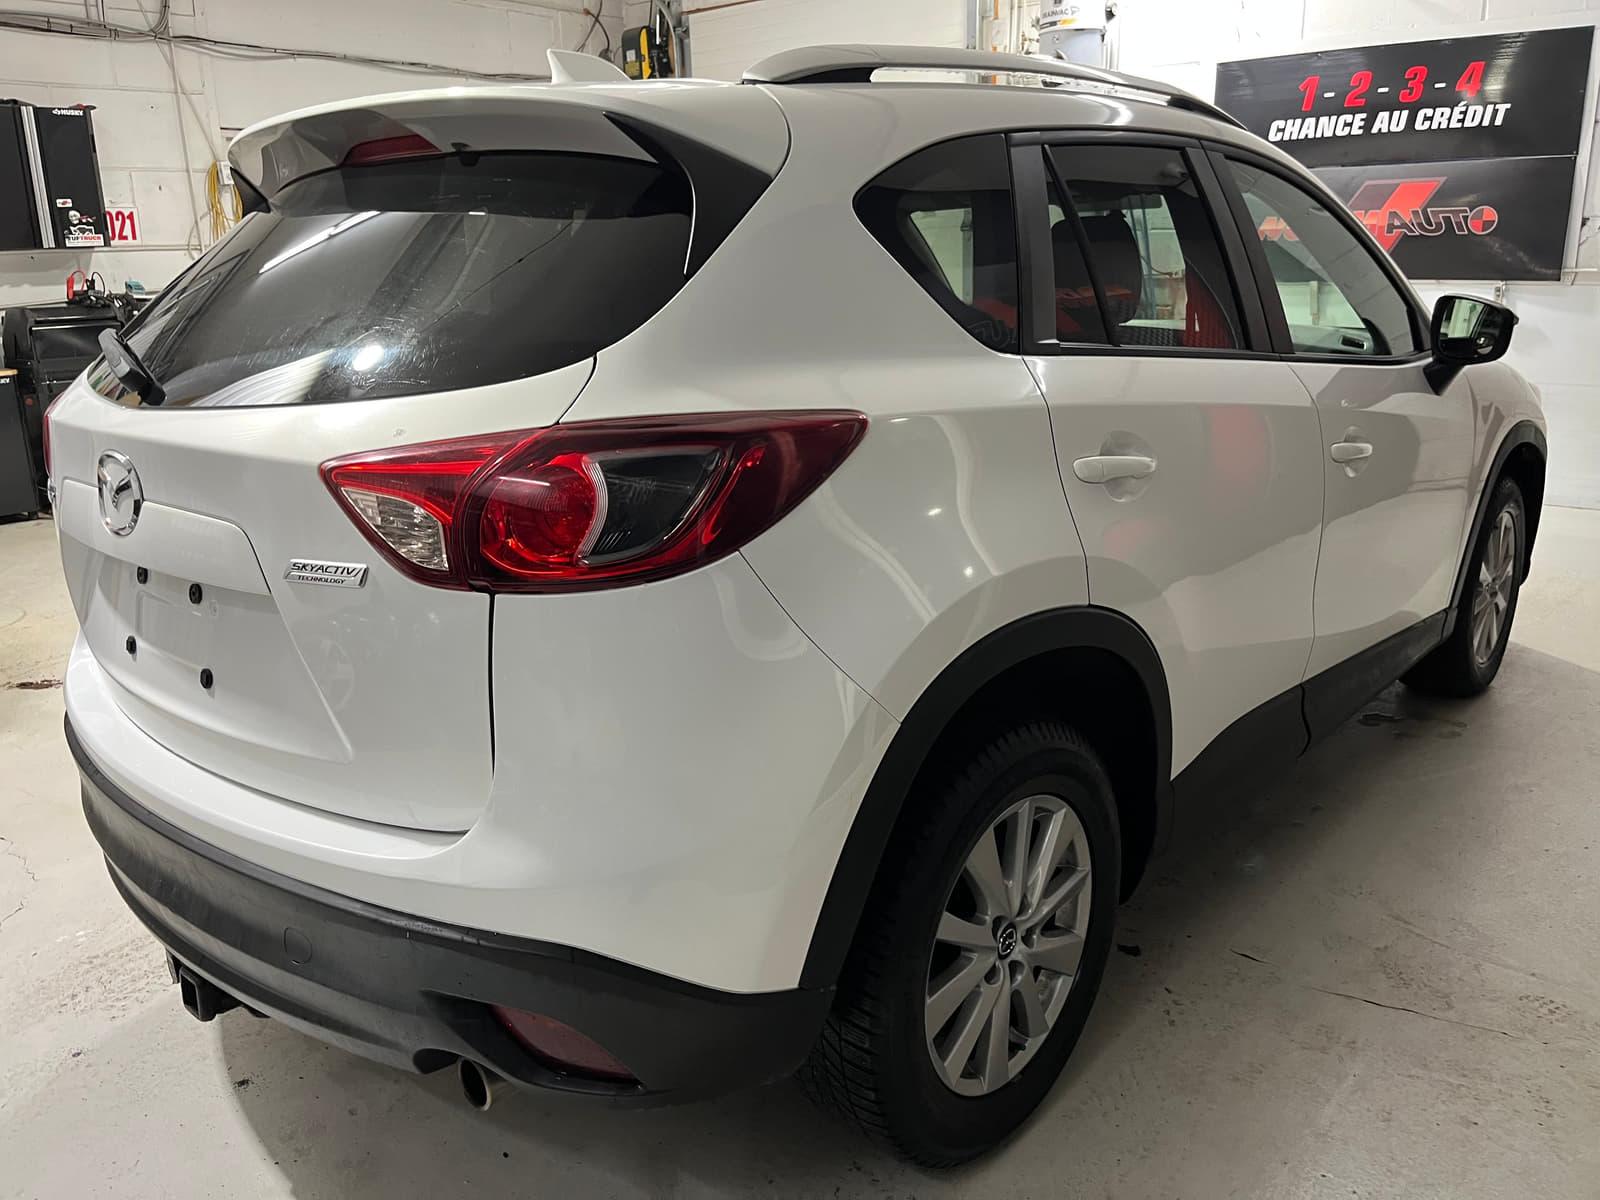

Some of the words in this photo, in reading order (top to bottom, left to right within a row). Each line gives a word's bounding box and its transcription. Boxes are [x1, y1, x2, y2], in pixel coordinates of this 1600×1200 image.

[1268, 112, 1367, 142] CHANCE
[1371, 109, 1410, 134] AU
[1414, 101, 1512, 131] CRÉDIT
[1385, 205, 1499, 237] AUTO
[291, 562, 360, 577] SKYACTIV
[297, 574, 346, 584] TECHNOLOGY
